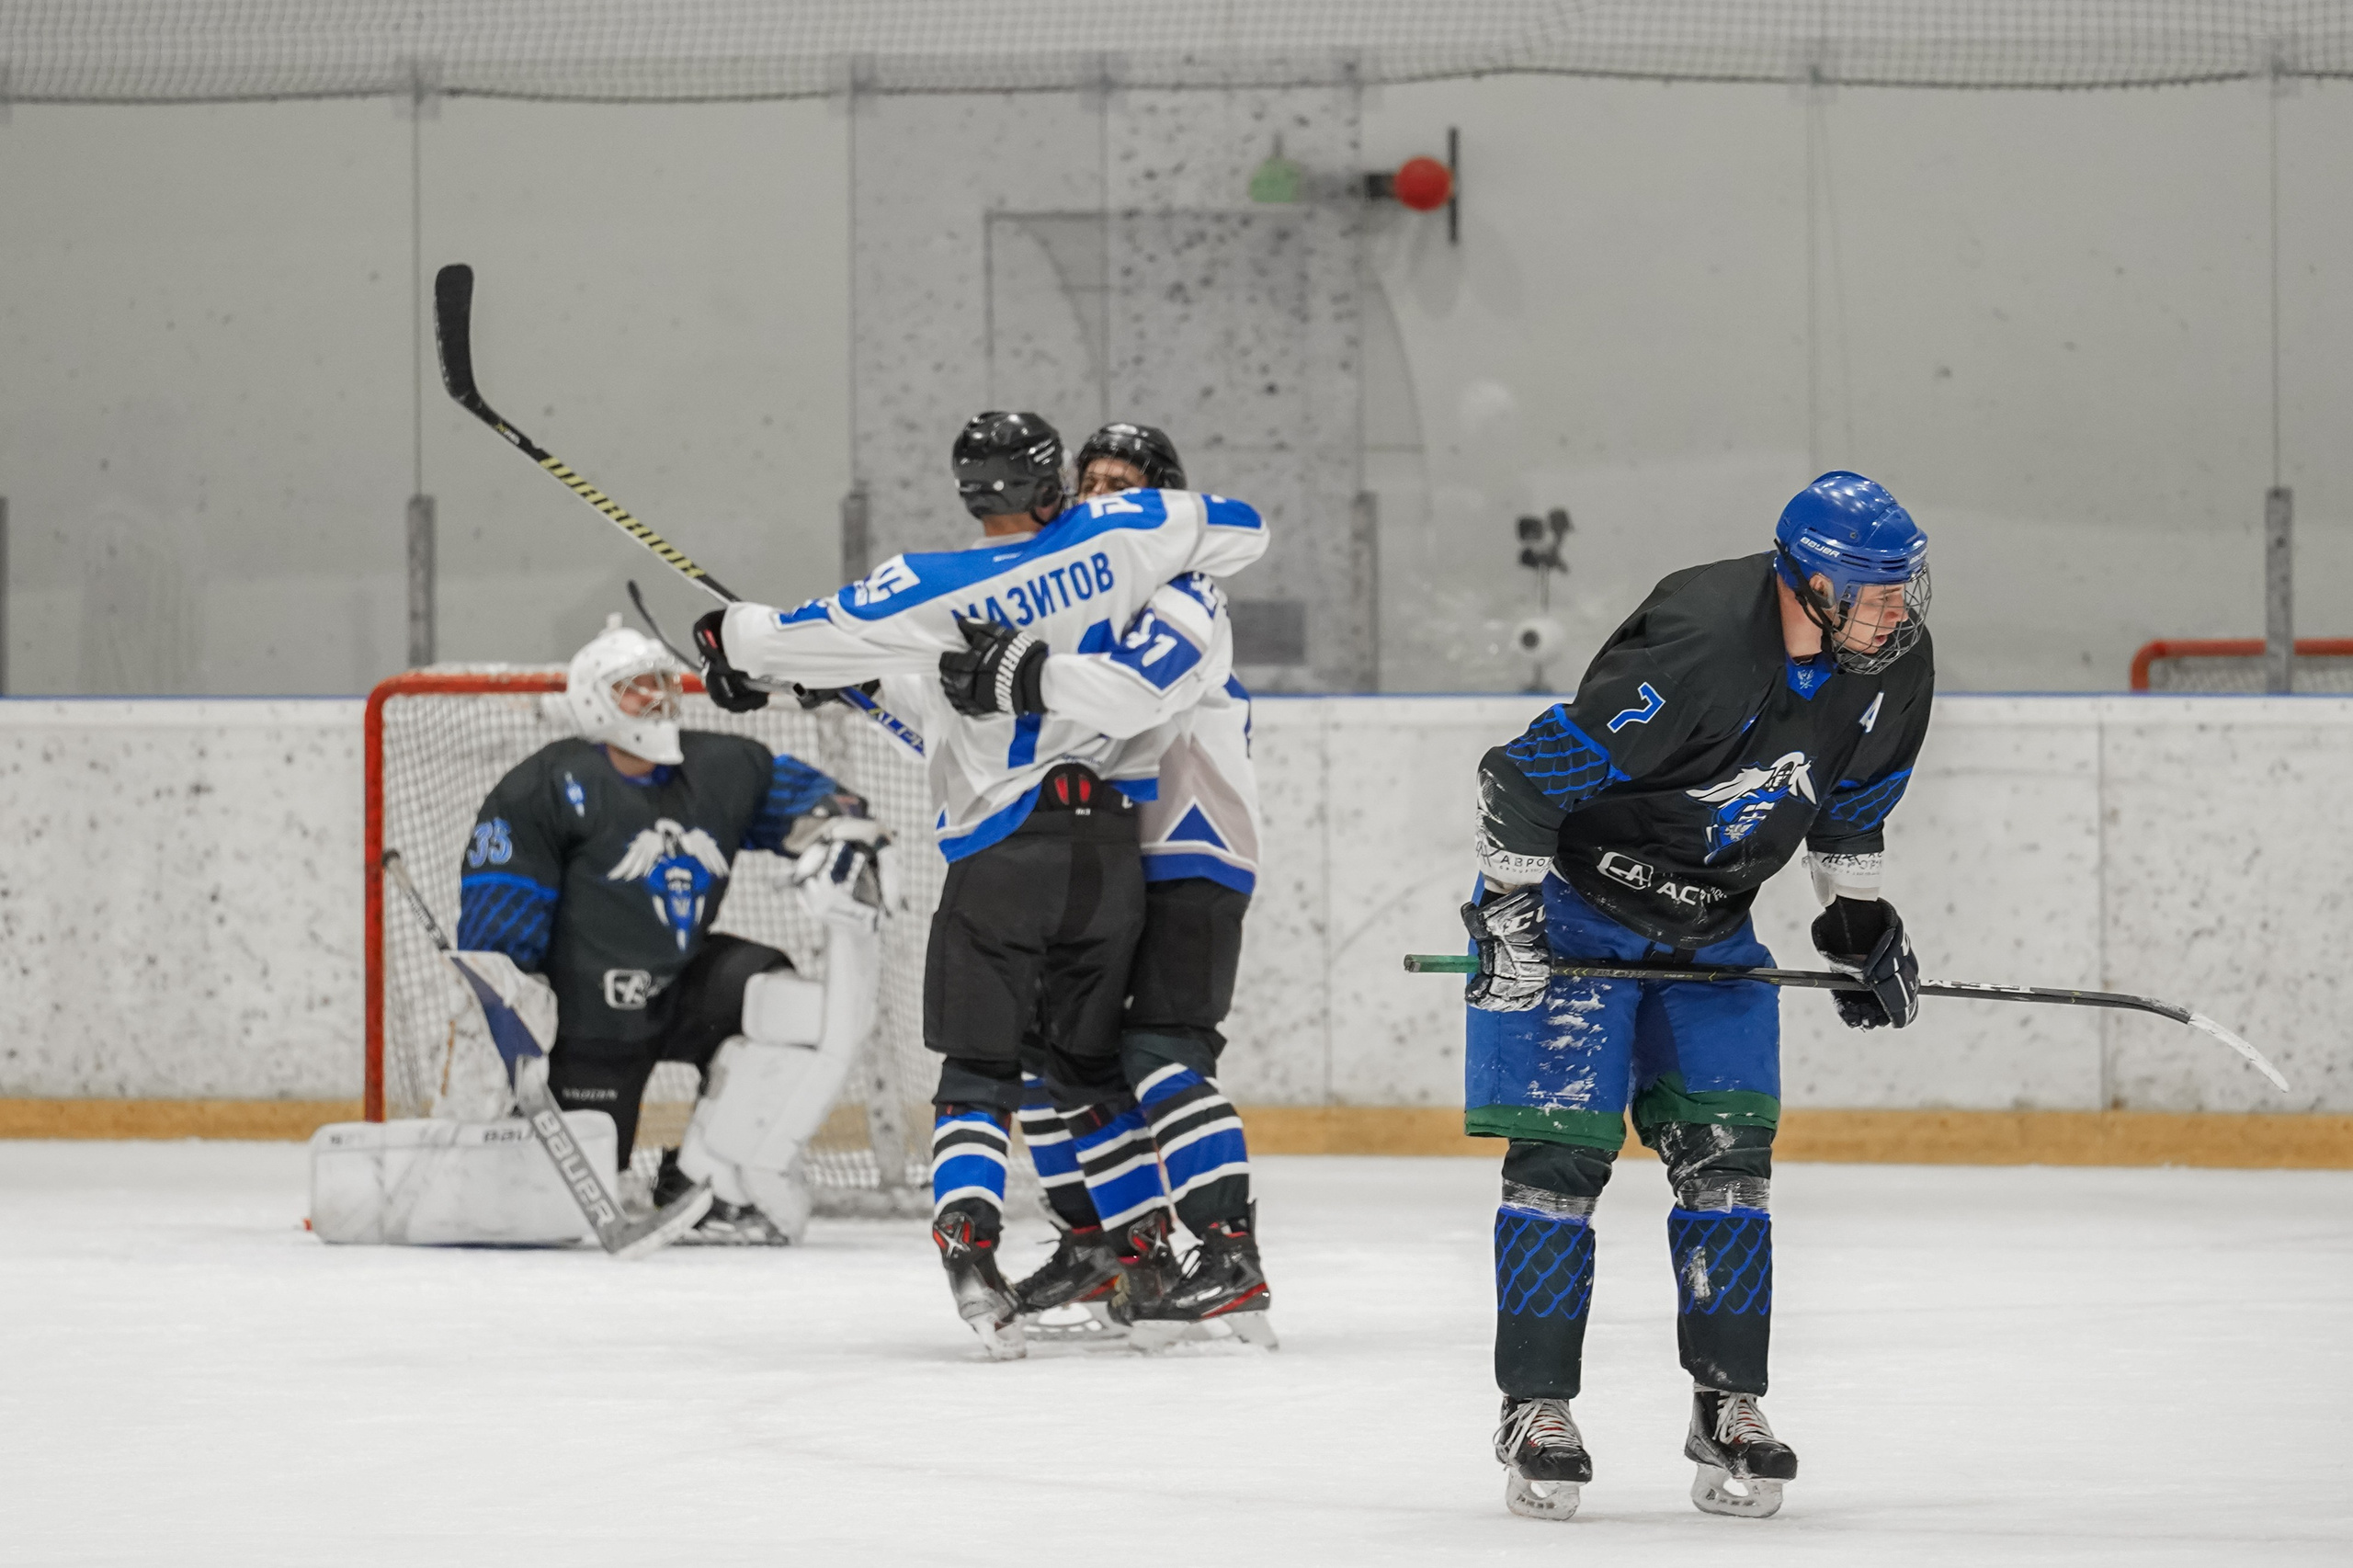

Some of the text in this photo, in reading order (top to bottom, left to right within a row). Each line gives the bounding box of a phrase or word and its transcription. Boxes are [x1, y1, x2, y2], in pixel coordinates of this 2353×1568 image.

[1800, 536, 1841, 558] BAUER
[1607, 682, 1666, 733] 7
[1859, 690, 1884, 733] A
[467, 817, 512, 869] 35
[532, 1109, 615, 1226] BAUER
